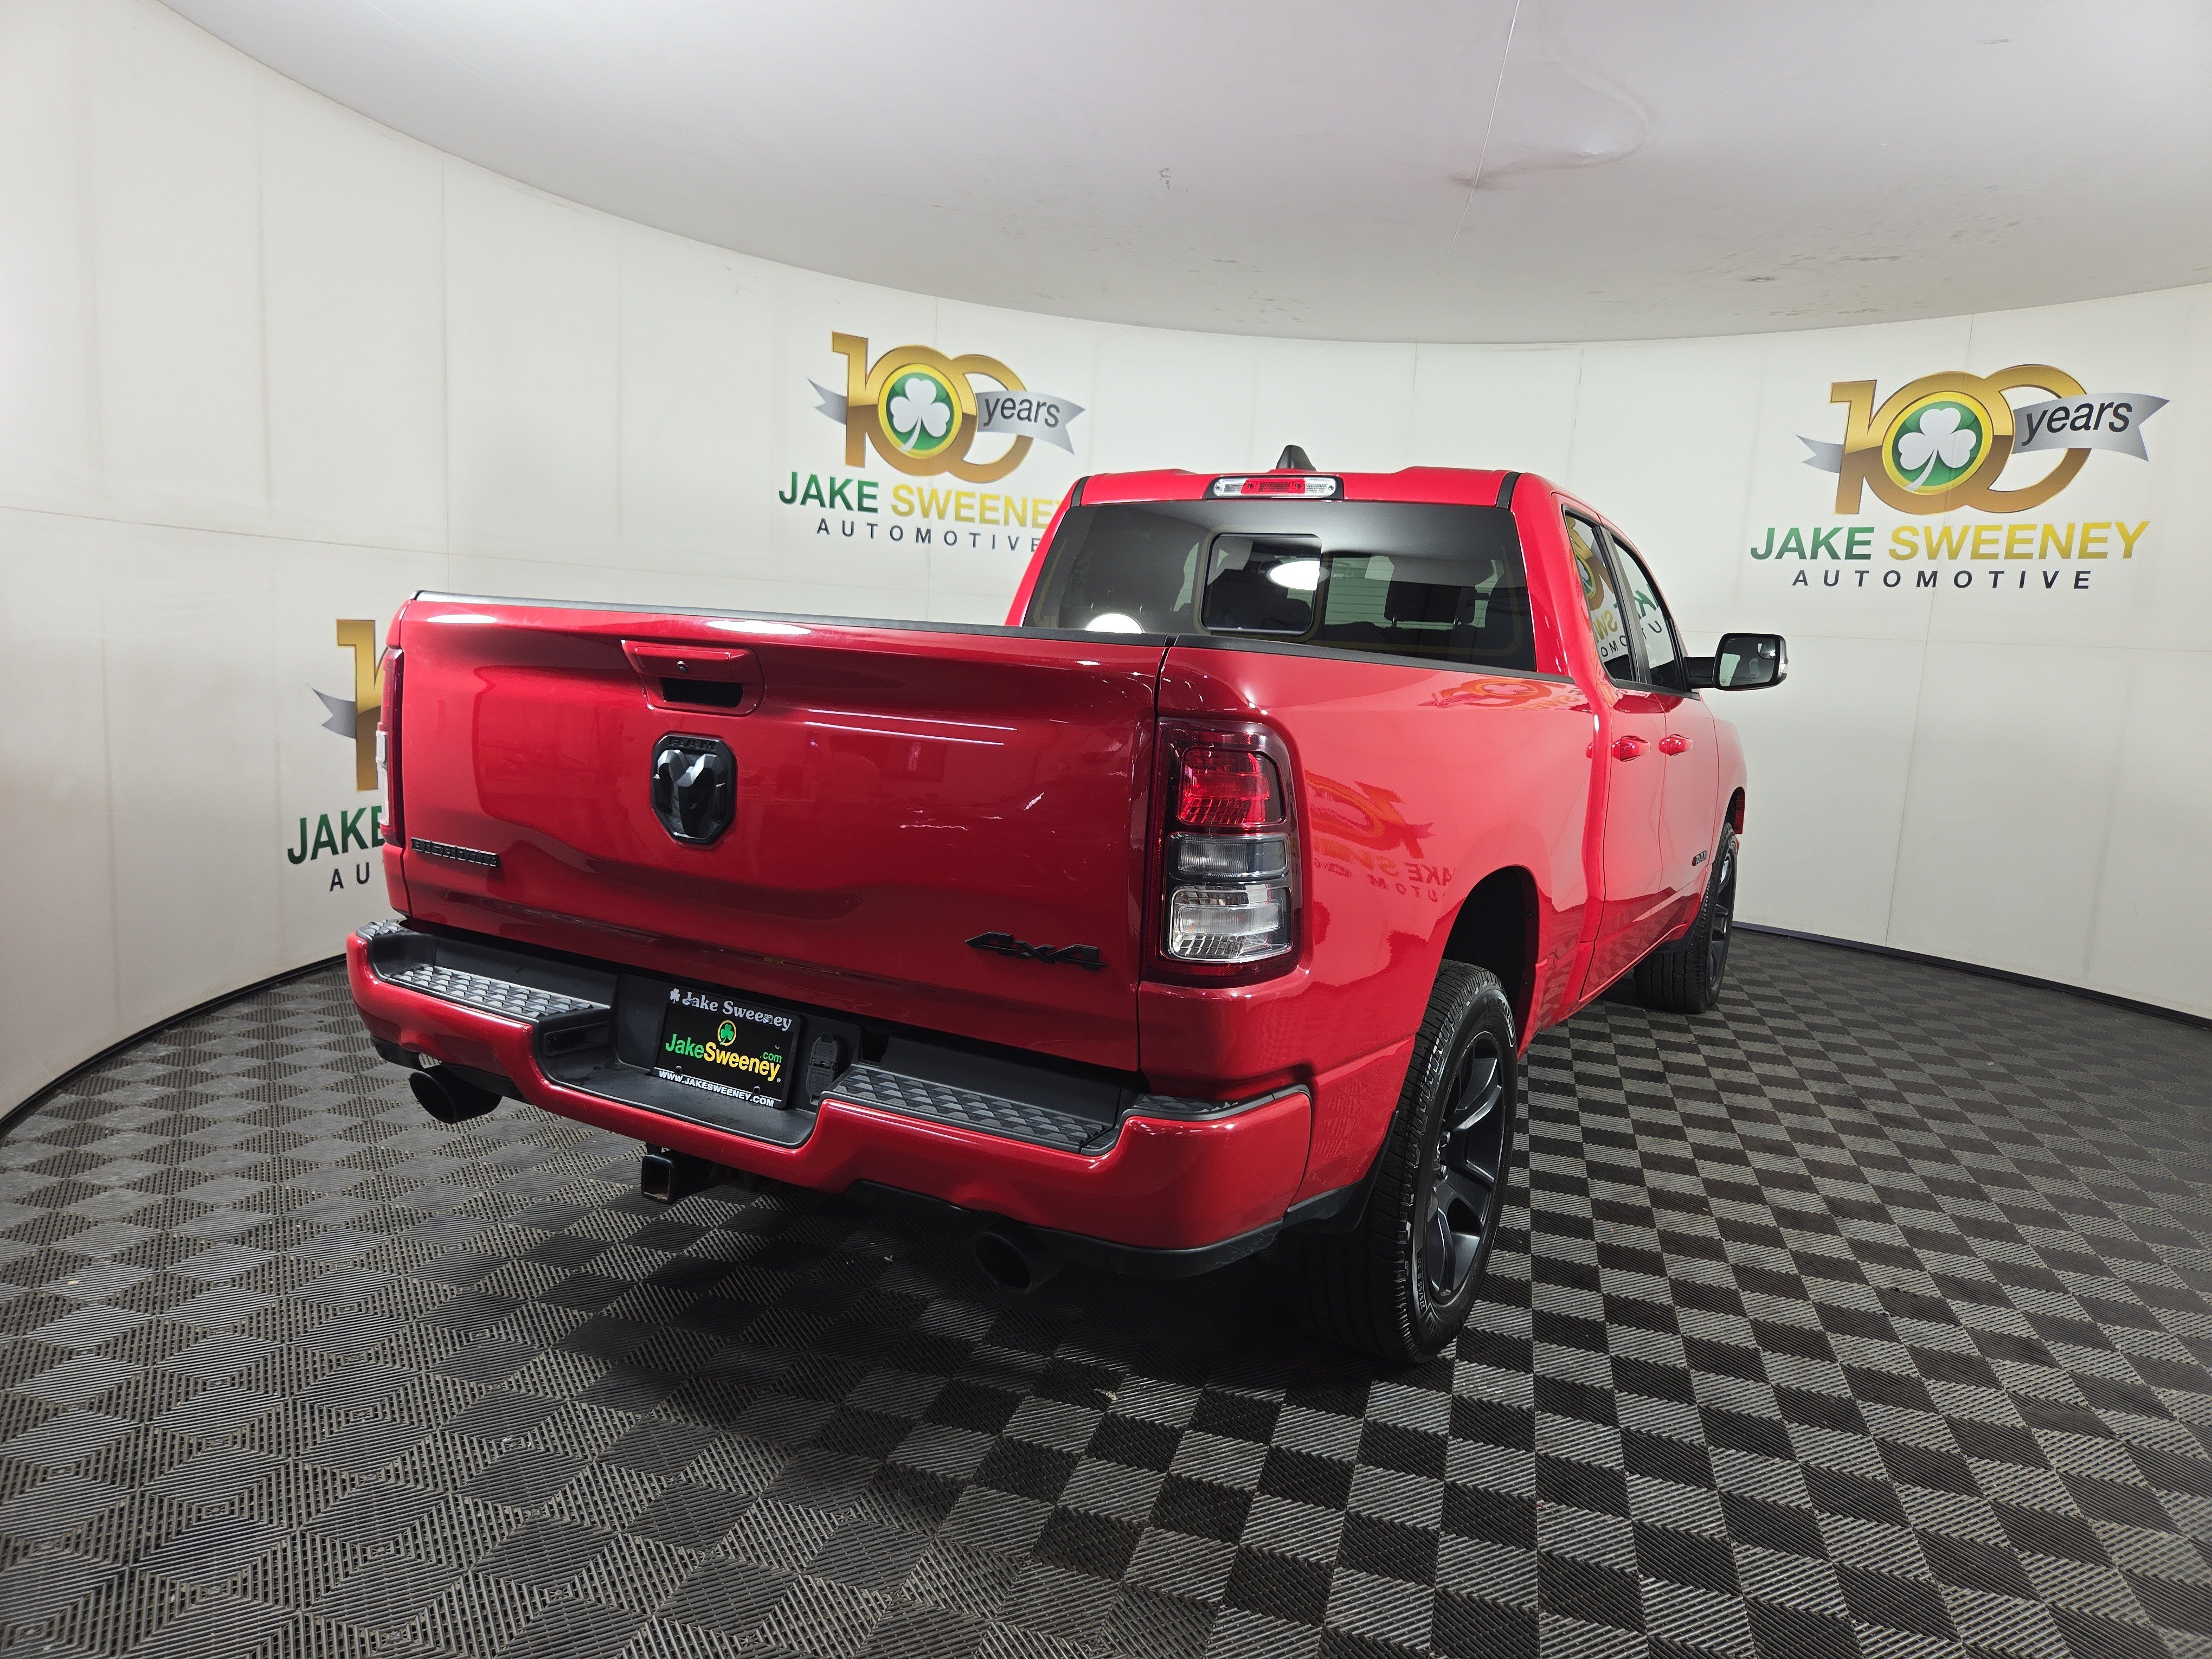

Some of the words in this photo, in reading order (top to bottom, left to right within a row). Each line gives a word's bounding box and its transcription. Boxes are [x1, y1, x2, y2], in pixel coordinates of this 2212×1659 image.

[831, 331, 1034, 484] 100
[983, 396, 1060, 428] years
[1830, 364, 2092, 515] 100
[2021, 401, 2132, 448] years
[779, 471, 879, 512] JAKE
[891, 484, 1061, 529] SWEENE
[1750, 527, 1874, 560] JAKE
[1888, 520, 2150, 561] SWEENEY
[1792, 570, 2091, 589] AUTOMOTIVE
[669, 737, 717, 751] RAM
[682, 991, 718, 1012] Jake
[659, 1070, 774, 1107] WWW.JAKESWEENEY.COM
